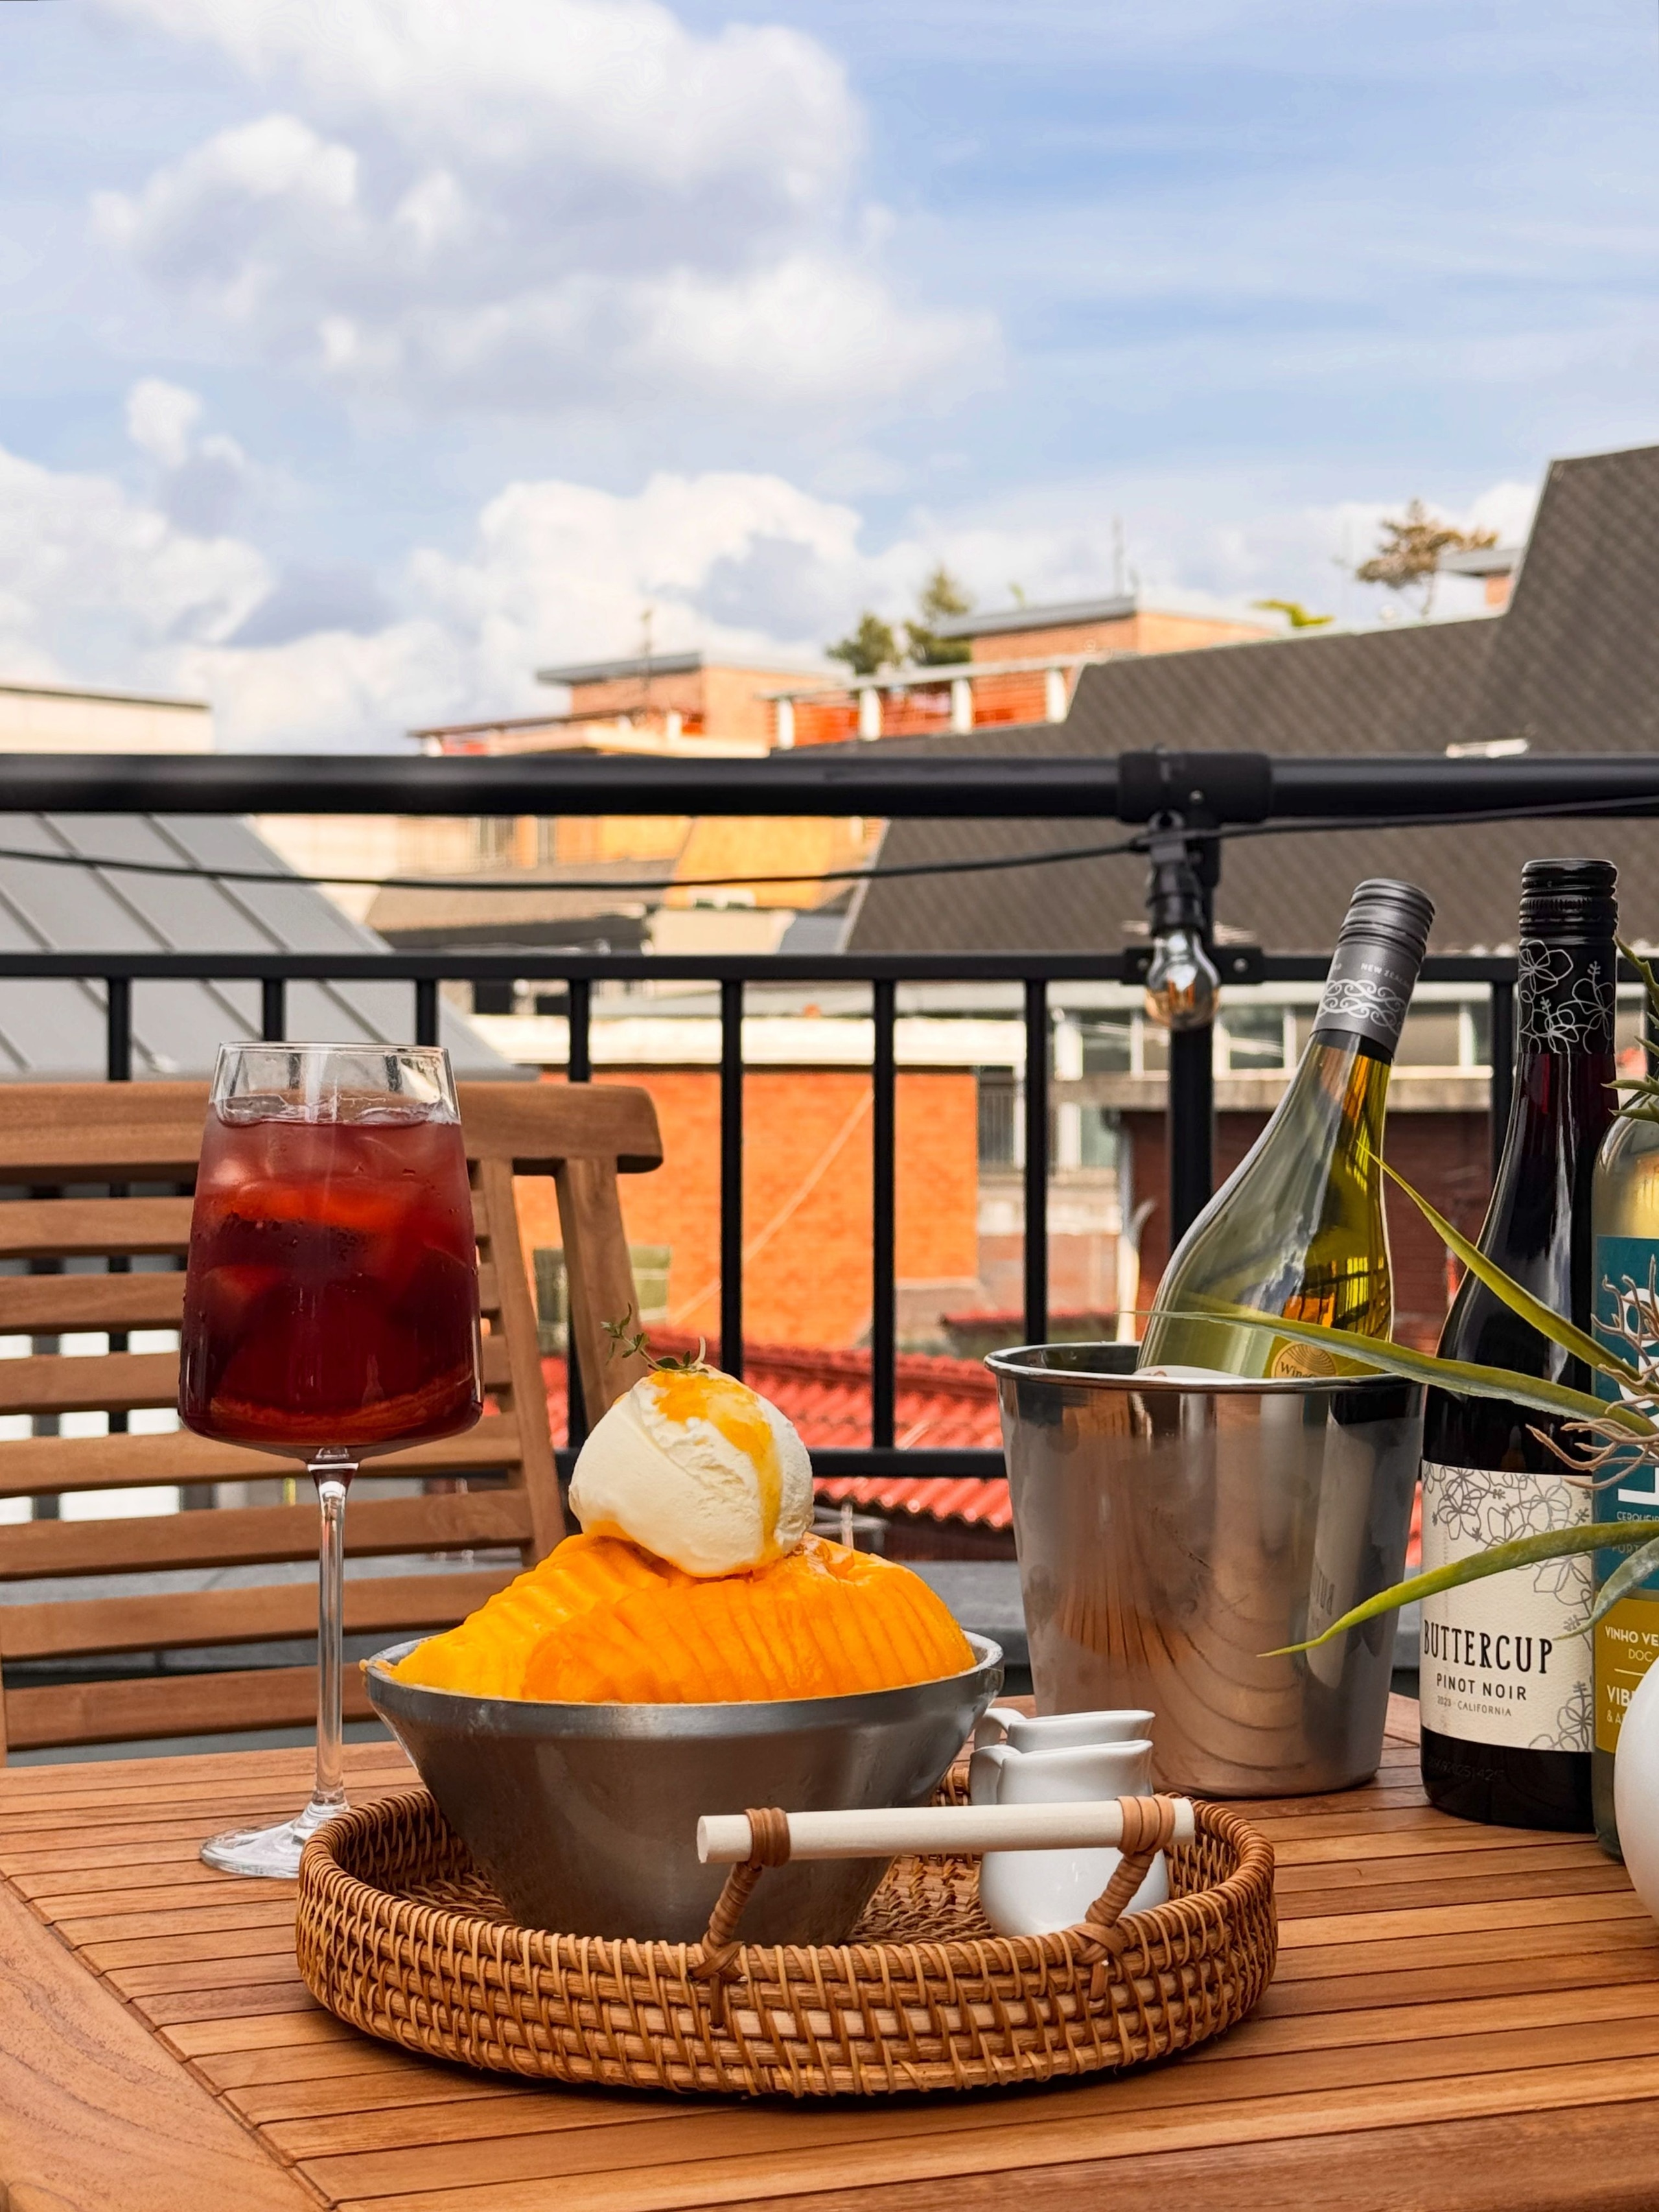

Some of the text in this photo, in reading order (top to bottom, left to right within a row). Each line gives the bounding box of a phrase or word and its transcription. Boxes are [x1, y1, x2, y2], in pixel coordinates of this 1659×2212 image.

[1360, 962, 1382, 974] NEW
[1605, 1625, 1639, 1644] VINHO
[1424, 1619, 1553, 1673] BUTTERCUP
[1628, 1648, 1653, 1662] DOC
[1437, 1673, 1527, 1700] PINOT NOIR
[1457, 1700, 1512, 1717] CALIFORNIA
